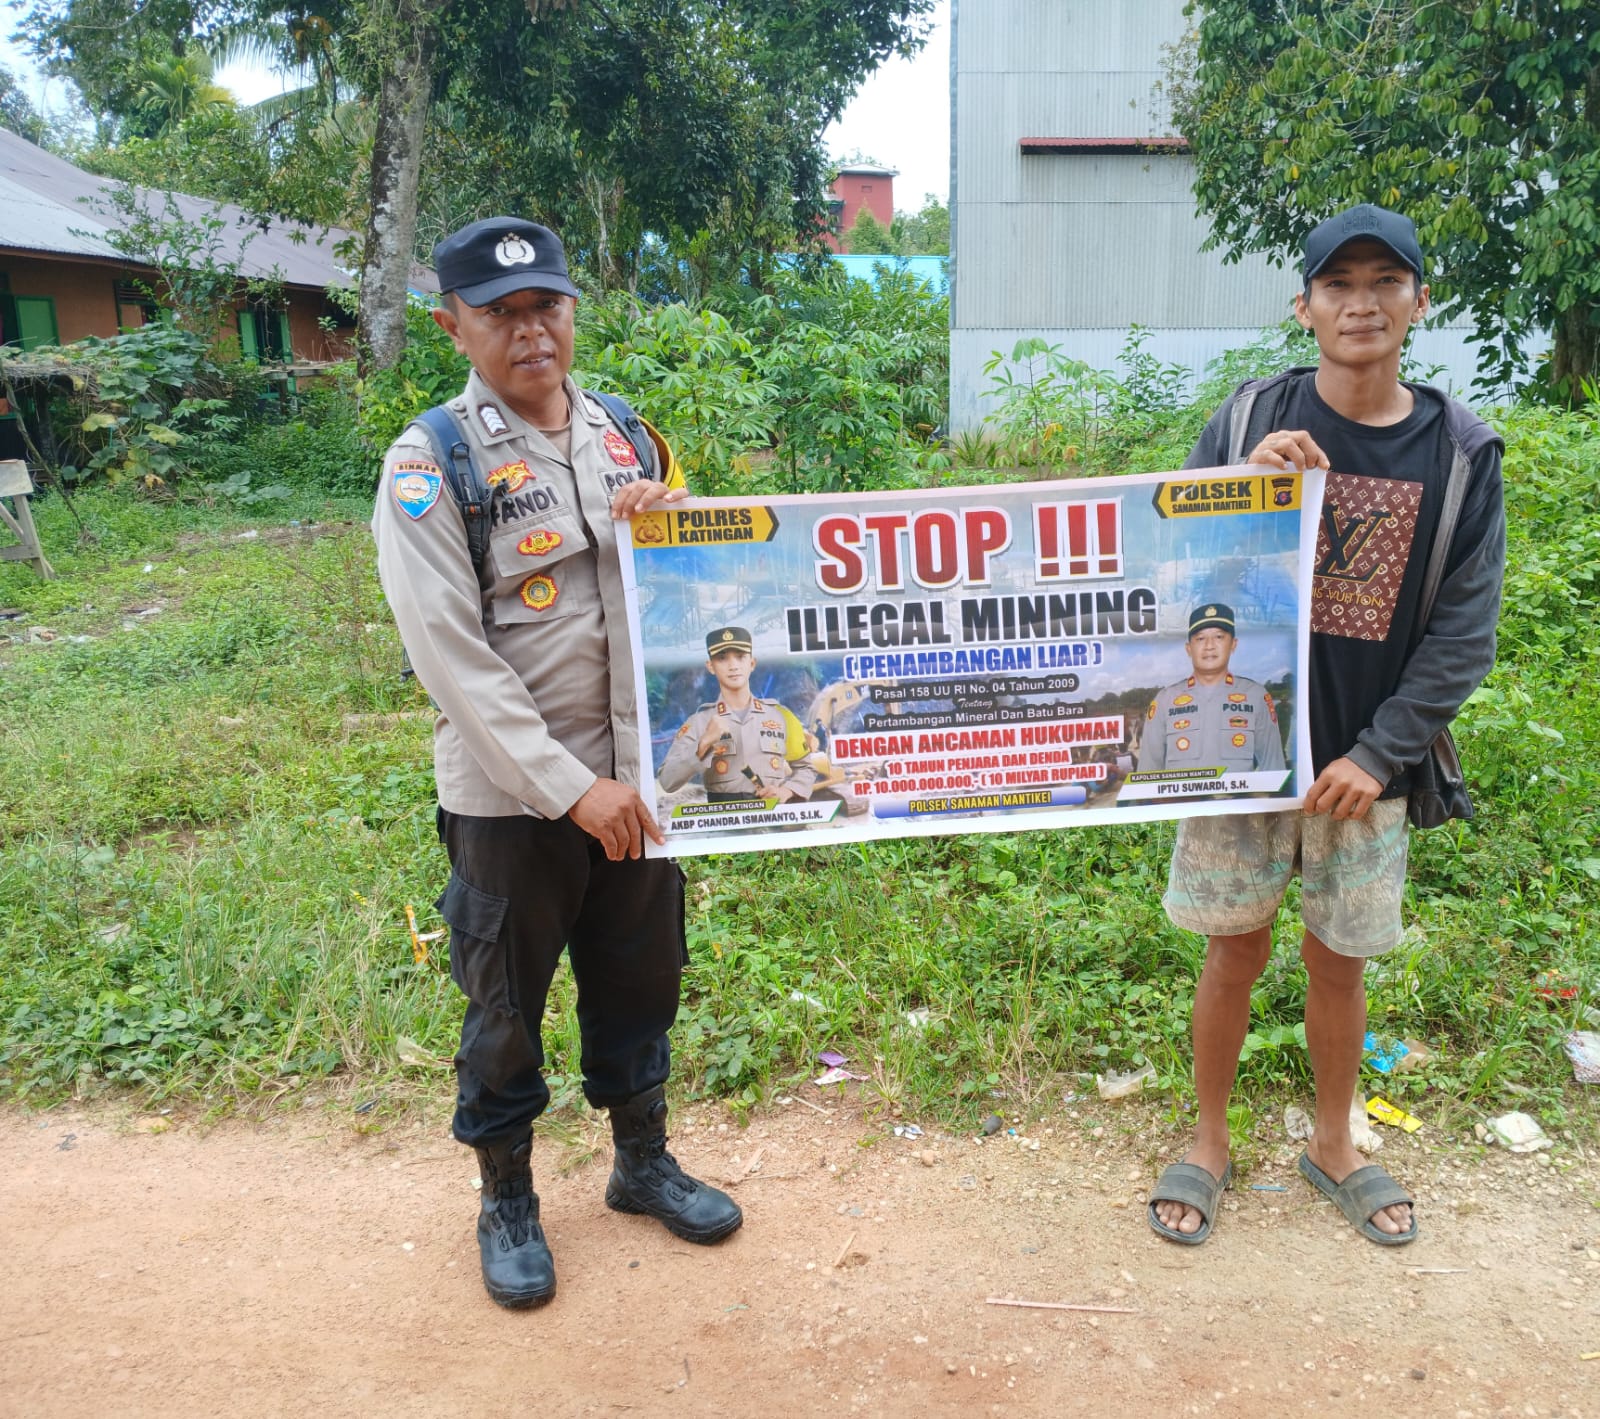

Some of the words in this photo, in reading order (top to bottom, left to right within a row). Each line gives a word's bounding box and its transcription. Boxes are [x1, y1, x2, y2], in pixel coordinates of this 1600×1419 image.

[398, 464, 436, 472] BINMAS
[1170, 480, 1252, 502] POLSEK
[677, 508, 753, 529] POLRES
[679, 527, 754, 544] KATINGAN
[815, 508, 1011, 592] STOP
[1034, 500, 1121, 580] !!!
[786, 600, 952, 652] ILLEGAL
[960, 586, 1158, 643] MINNING
[858, 646, 1032, 678] PENAMBANGAN
[1038, 643, 1089, 668] LIAR
[874, 687, 906, 700] Pasal
[909, 685, 930, 698] 158
[933, 684, 951, 696] UU
[954, 683, 966, 695] RI
[970, 682, 990, 694] No.
[992, 682, 1006, 693] 04
[1009, 679, 1045, 692] Tahun
[1048, 678, 1076, 690] 2009
[957, 698, 993, 710] Tentang
[1222, 703, 1254, 713] POLRI
[868, 712, 952, 728] Pertambangan
[956, 709, 998, 722] Mineral
[1001, 708, 1025, 720] Dan
[1028, 706, 1054, 718] Batu
[1057, 704, 1084, 716] Bara
[835, 734, 914, 759] DENGAN
[918, 728, 1016, 754] ANCAMAN
[1020, 721, 1120, 746] HUKUMAN
[887, 762, 902, 776] 10
[904, 759, 946, 775] TAHUN
[948, 756, 1000, 772] PENJARA
[1002, 753, 1028, 767] DAN
[1029, 750, 1069, 766] DENDA
[854, 782, 873, 796] RP.
[989, 772, 1003, 786] 10
[1006, 769, 1048, 784] MILYAR
[1051, 766, 1097, 781] RUPIAH
[1157, 782, 1180, 794] IPTU
[1182, 780, 1228, 793] SUWARDI,
[1230, 780, 1249, 790] S.H.
[682, 804, 724, 815] KAPOLRES
[725, 802, 765, 812] KATINGAN
[908, 798, 949, 814] POLSEK
[950, 795, 1000, 811] SANAMAN
[1002, 792, 1052, 808] MANTIKEI
[671, 820, 696, 831] AKBP
[697, 816, 740, 828] CHANDRA
[742, 812, 798, 825] ISMAWANTO,
[800, 810, 823, 820] S.I.K.
